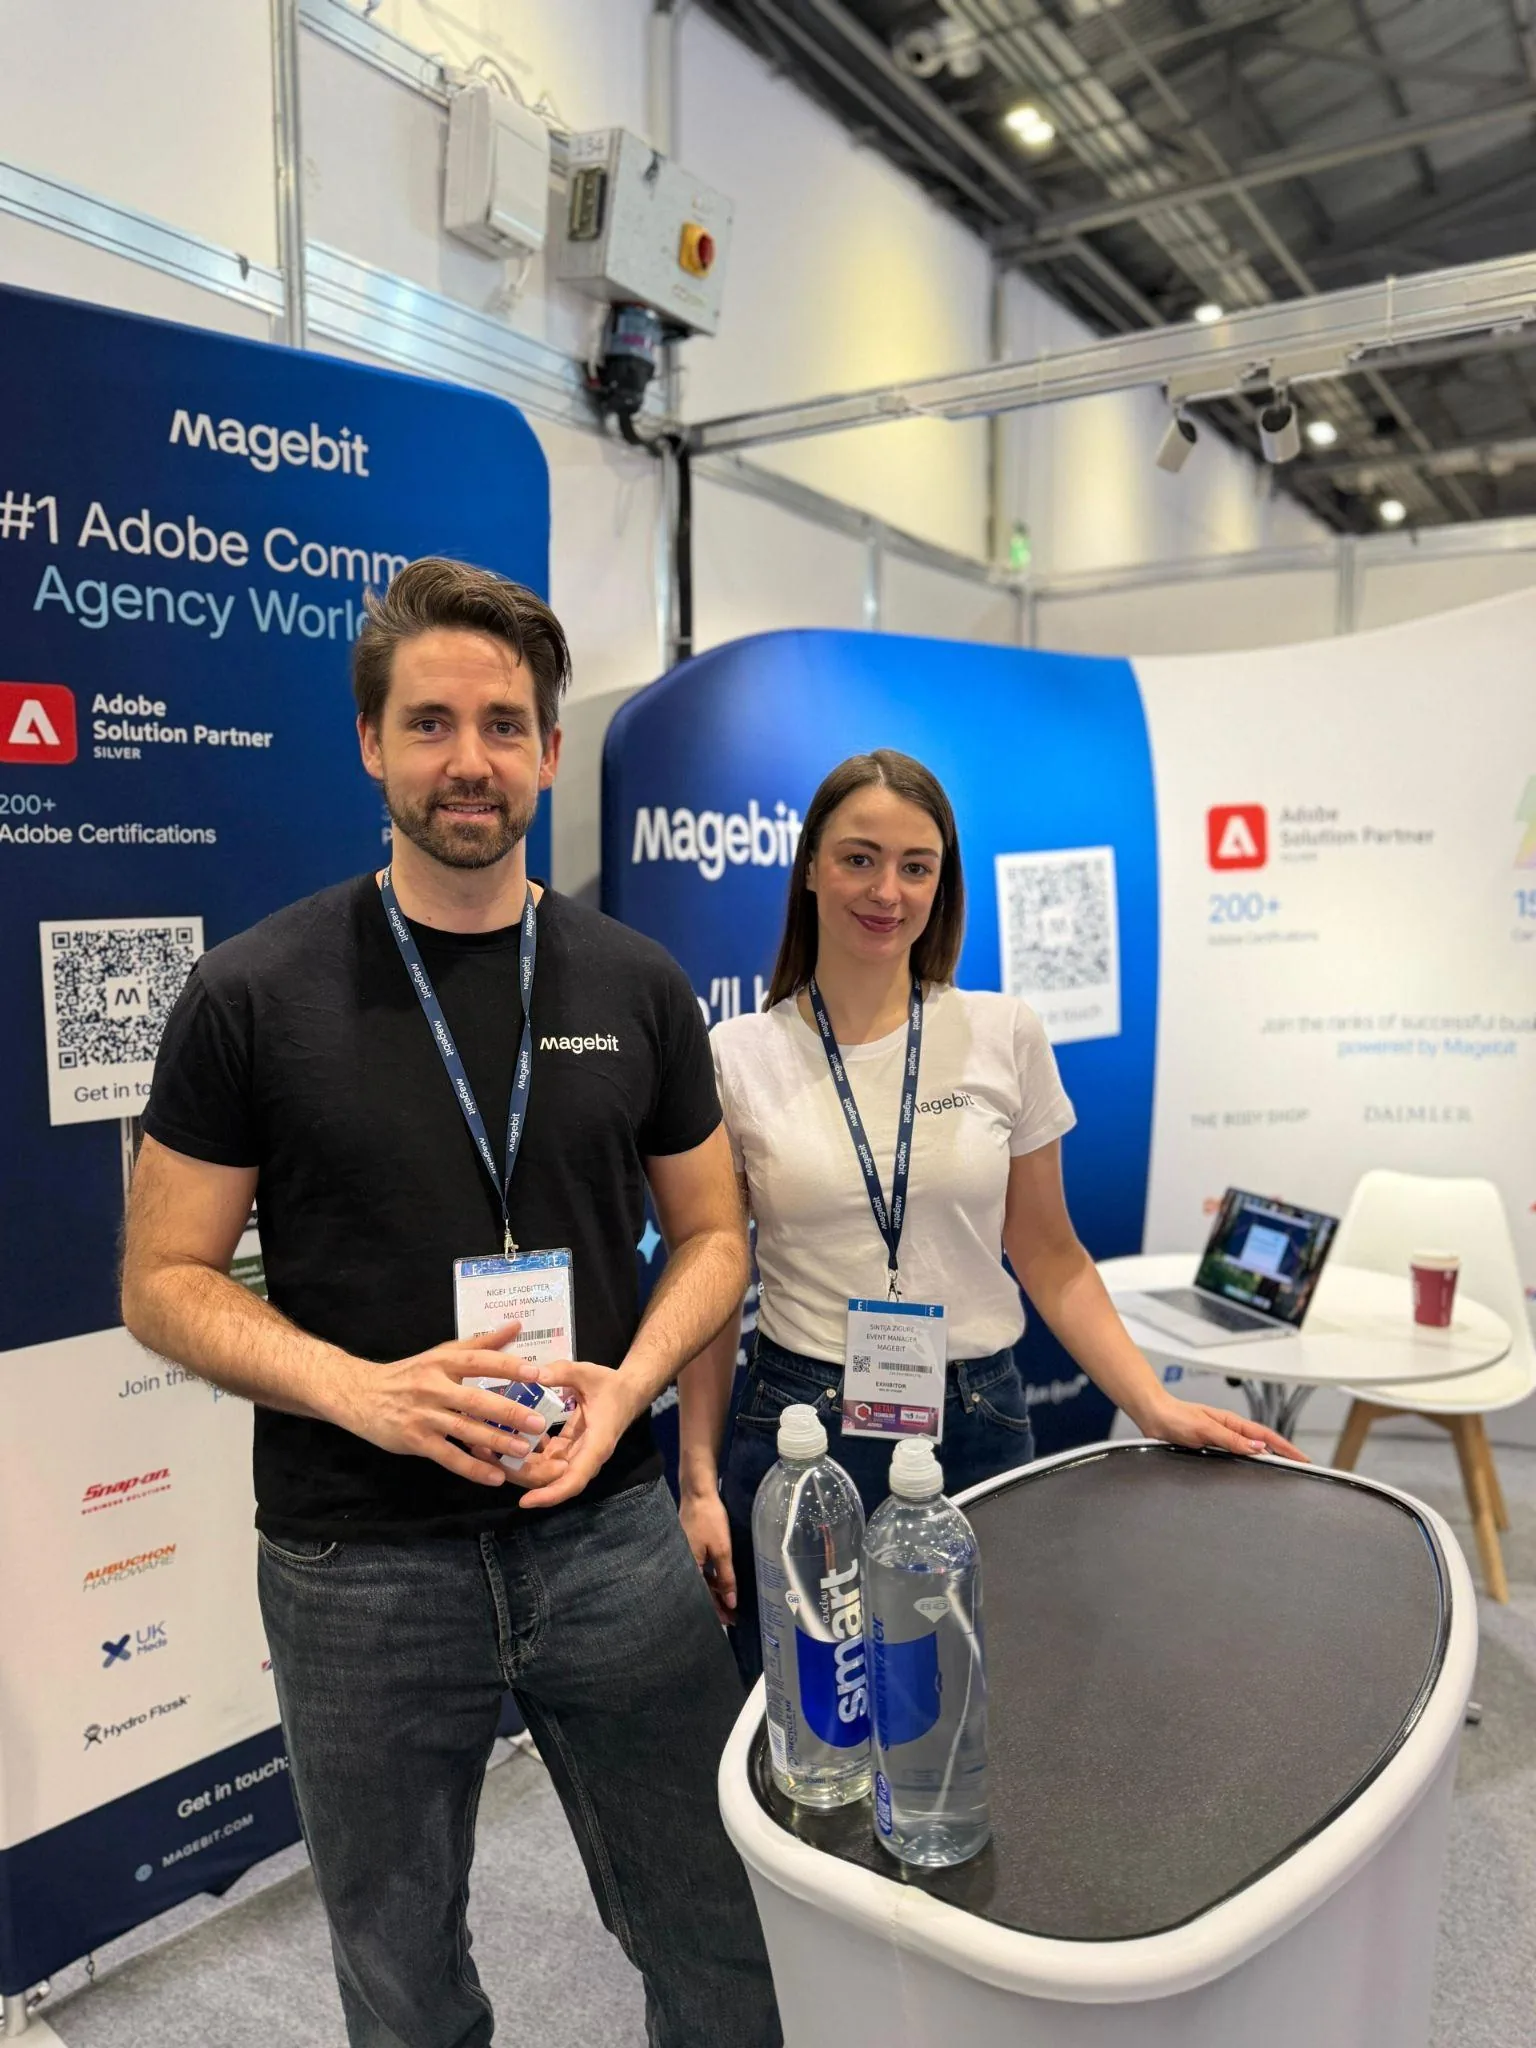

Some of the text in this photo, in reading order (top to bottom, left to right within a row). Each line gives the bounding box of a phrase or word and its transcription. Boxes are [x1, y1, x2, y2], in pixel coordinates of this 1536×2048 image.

[169, 408, 370, 477] Magebit
[0, 490, 59, 544] #1
[78, 501, 249, 567] Adobe
[33, 564, 235, 639] Agency
[92, 692, 167, 718] Adobe
[93, 720, 273, 747] Solution Partner
[93, 746, 142, 760] SILVER
[0, 793, 57, 815] 200+
[0, 823, 217, 845] Adobe Certifications
[632, 799, 803, 881] Magebit
[388, 907, 410, 944] Magebit
[525, 903, 534, 938] Magebit
[1207, 892, 1281, 924] 200+
[410, 962, 432, 1000] Magebit
[432, 1019, 455, 1058] Magebit
[540, 1033, 620, 1054] Magebit
[517, 1050, 530, 1090] Magebit
[74, 1085, 109, 1103] Get
[113, 1082, 130, 1099] in
[456, 1077, 477, 1116] Magebit
[914, 1092, 975, 1115] agebit
[508, 1112, 521, 1153] Magebit
[478, 1137, 498, 1175] Magebit
[503, 1309, 536, 1320] MAGEBIT
[118, 1376, 160, 1398] Join
[84, 1543, 176, 1582] AUBUCHON
[136, 1620, 166, 1644] UK
[820, 1558, 869, 1724] smart
[103, 1713, 148, 1739] Hydro
[177, 1756, 290, 1818] Get in touch:
[162, 1813, 254, 1868] MAGEBIT.COM
